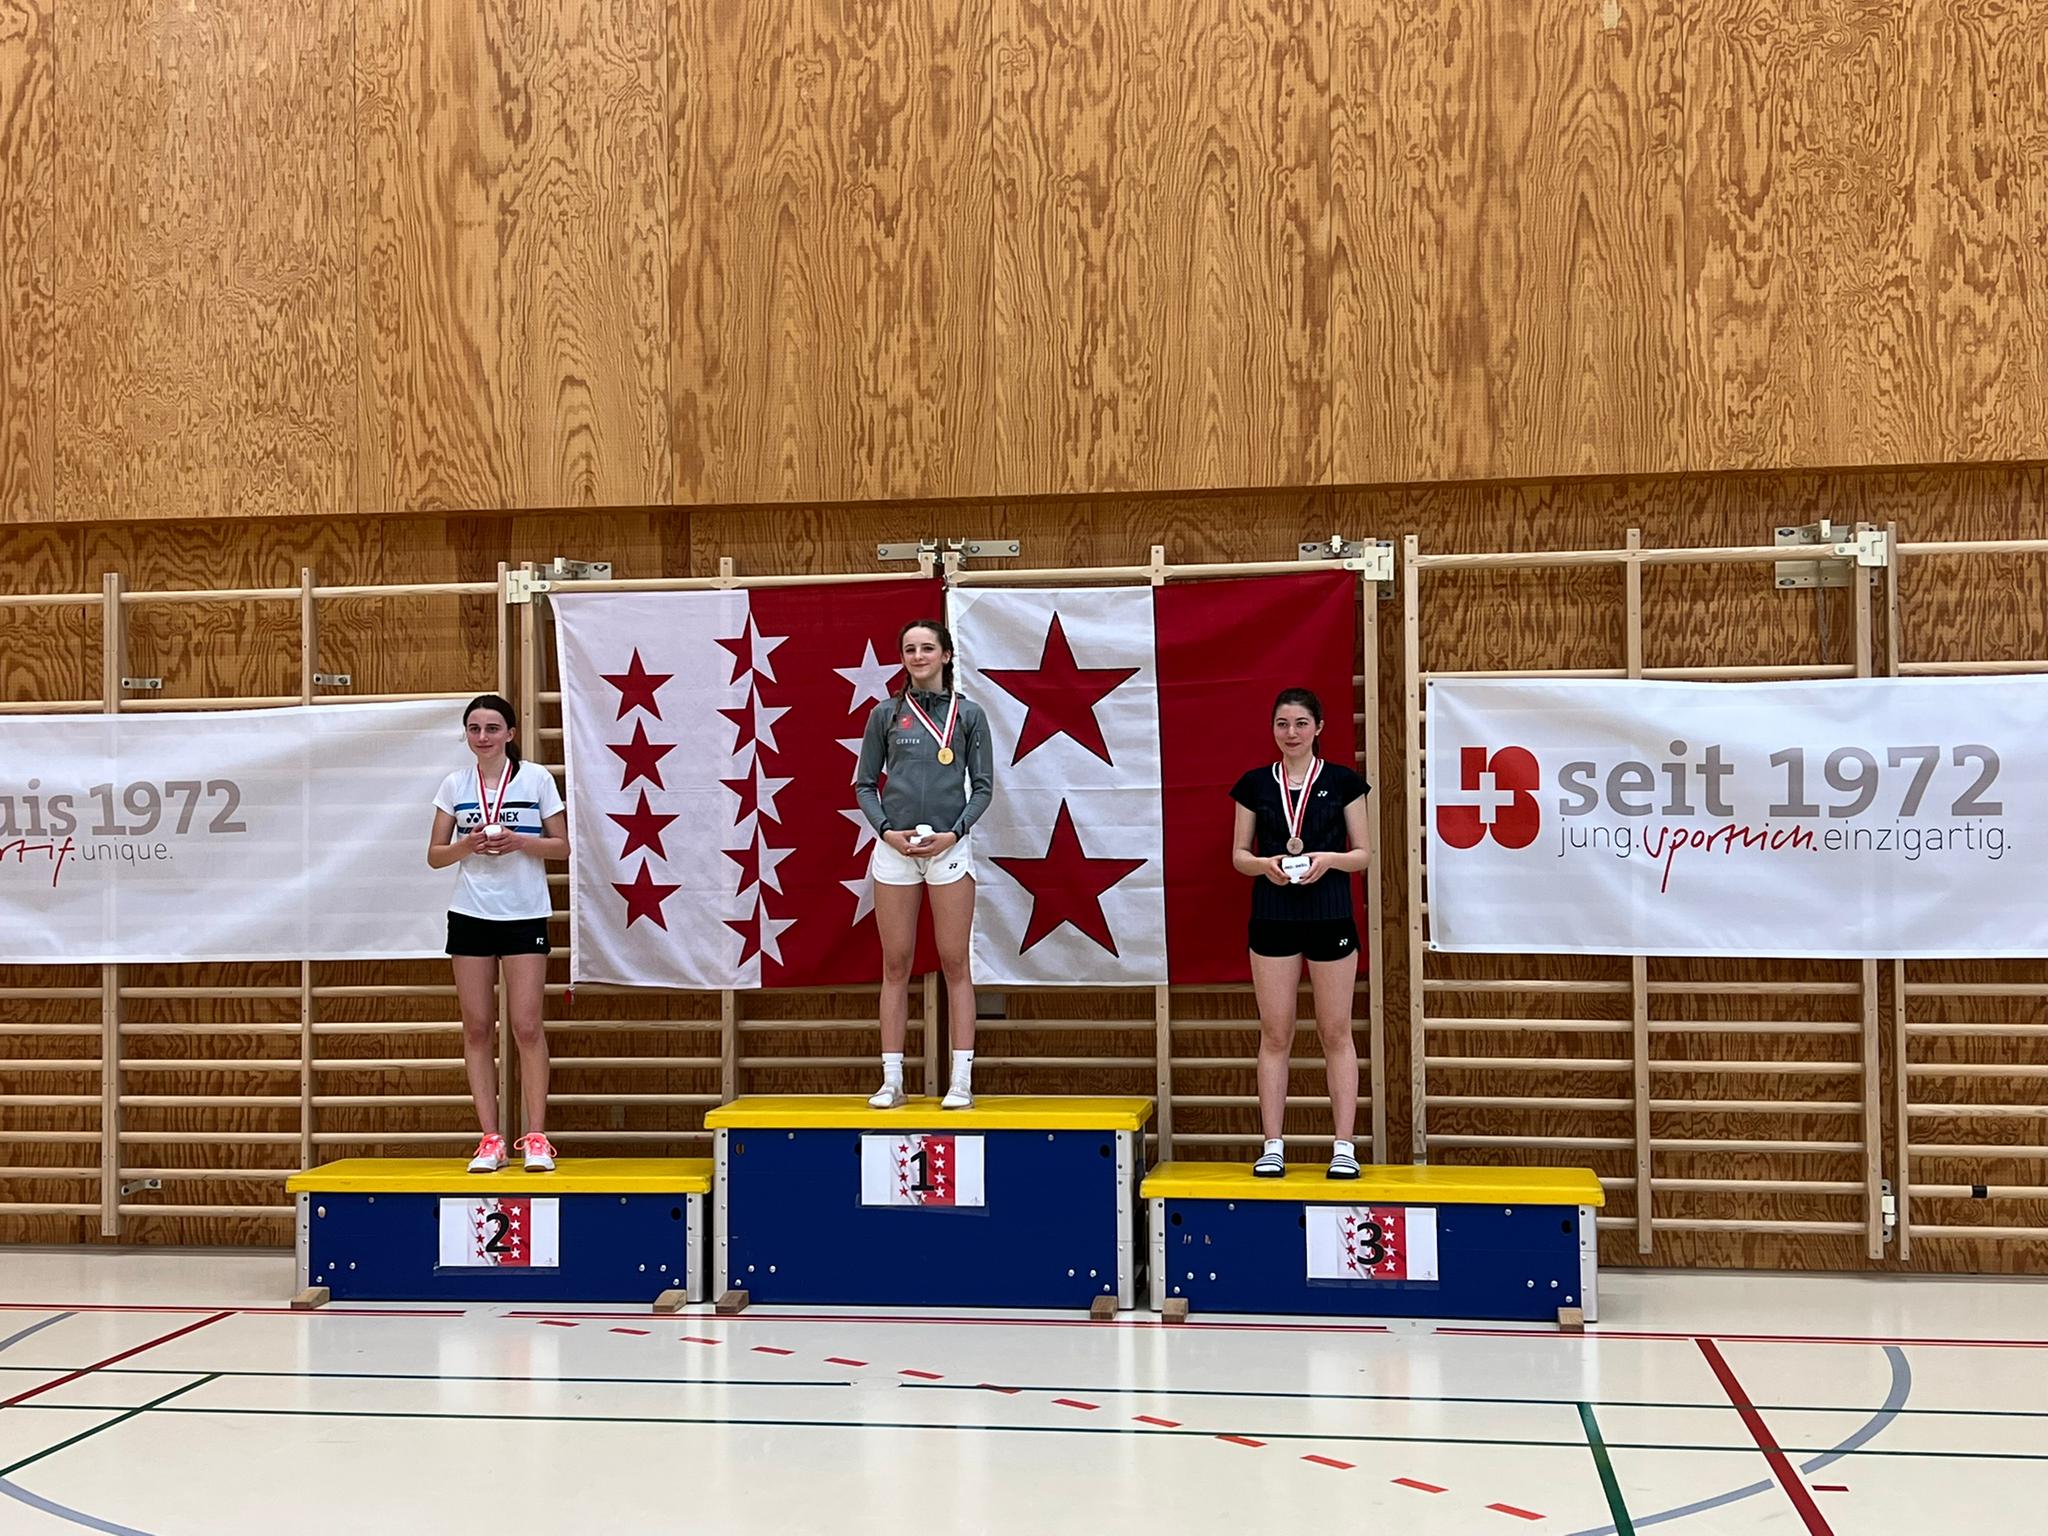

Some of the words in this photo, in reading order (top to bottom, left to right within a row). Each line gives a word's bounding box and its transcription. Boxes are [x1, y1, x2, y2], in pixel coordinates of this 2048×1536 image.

[1557, 740, 1734, 817] seit
[1769, 744, 2003, 818] 1972
[90, 778, 247, 836] 1972
[82, 837, 173, 867] unique.
[910, 1150, 935, 1191] 1
[485, 1212, 512, 1253] 2
[1356, 1222, 1385, 1265] 3
